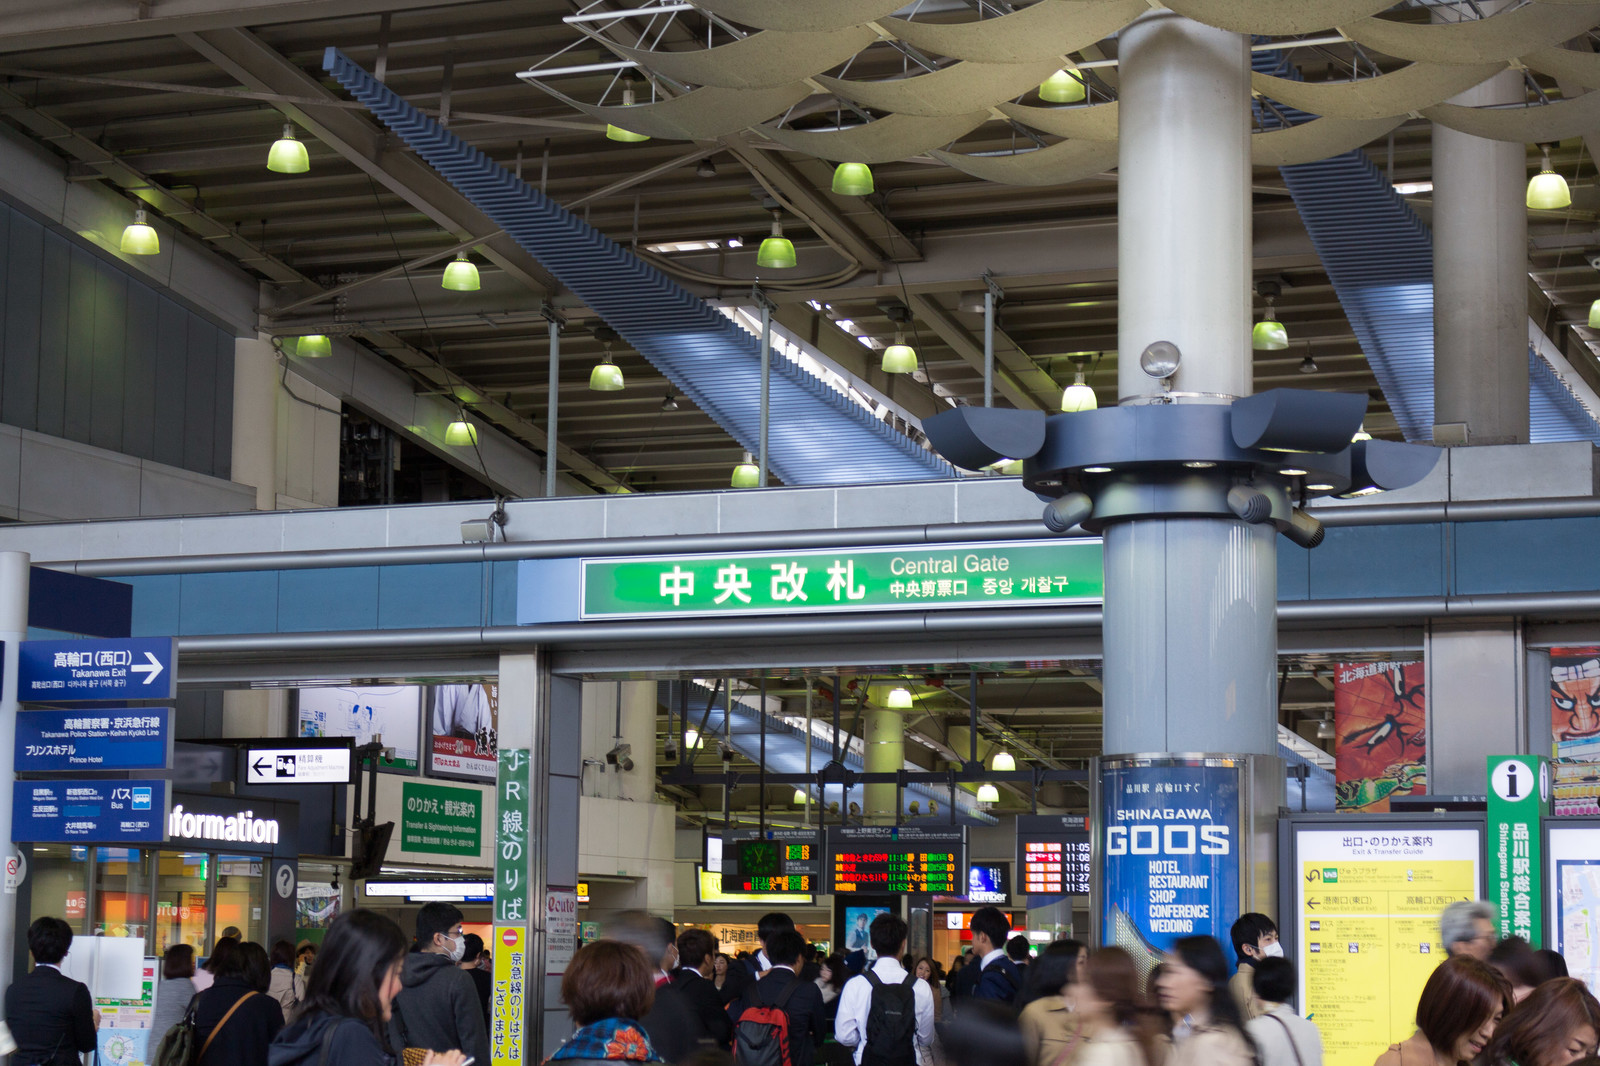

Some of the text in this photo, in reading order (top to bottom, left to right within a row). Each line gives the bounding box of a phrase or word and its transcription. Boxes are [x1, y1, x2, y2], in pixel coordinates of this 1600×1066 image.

[890, 553, 1009, 575] Central Gate
[659, 559, 866, 606] 中央改札
[889, 579, 968, 598] 中央剪票口
[982, 575, 1069, 595] 중앙 개찰구
[71, 668, 127, 678] Takanawa Exit
[70, 730, 87, 738] Police
[25, 745, 76, 756] プリンスホテル
[111, 787, 131, 800] バス
[1155, 781, 1201, 793] 高輪口すぐ
[407, 796, 475, 818] のりかえ・観光案内
[1117, 808, 1212, 821] SHINAGAWA
[406, 820, 424, 830] Transfer
[428, 822, 453, 834] Sightseeing
[453, 825, 476, 834] Information
[502, 752, 524, 920] JR線のりば
[1106, 824, 1230, 856] GOOS
[1343, 836, 1433, 847] 出口・のりかえ案内
[1066, 843, 1091, 852] 11:05
[1497, 822, 1509, 879] Shinagawa
[1066, 853, 1091, 862] 11:08
[1066, 863, 1091, 872] 11:16
[1149, 860, 1181, 874] HOTEL
[1066, 873, 1091, 882] 11:27
[1149, 875, 1210, 889] RESTAURANT
[1066, 883, 1091, 892] 11:35
[1149, 889, 1177, 904] SHOP
[1500, 880, 1510, 917] Station
[1149, 904, 1210, 918] CONFERENCE
[1150, 919, 1194, 933] WEDDING
